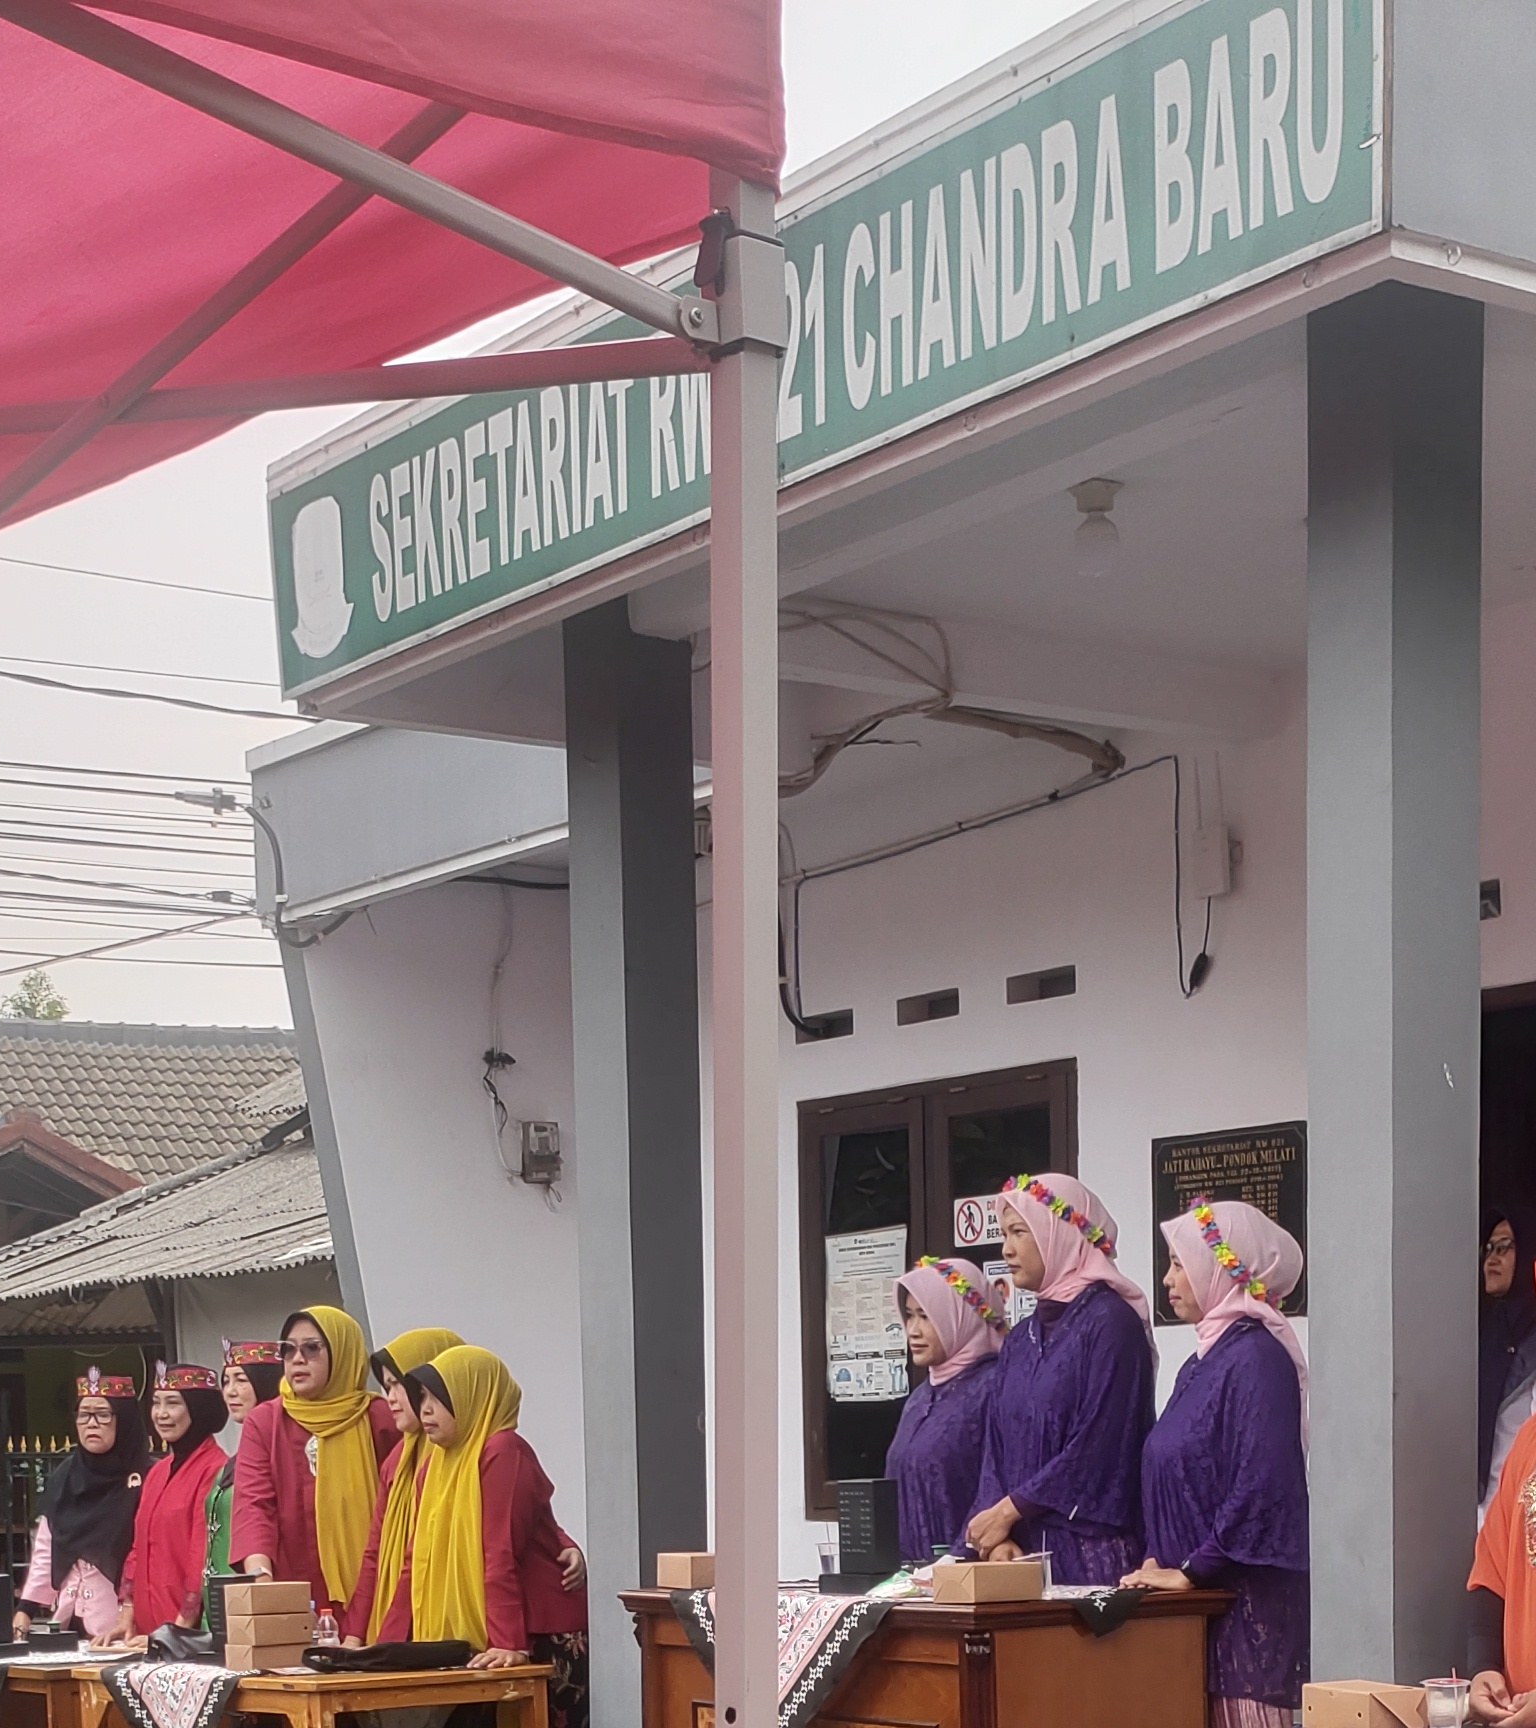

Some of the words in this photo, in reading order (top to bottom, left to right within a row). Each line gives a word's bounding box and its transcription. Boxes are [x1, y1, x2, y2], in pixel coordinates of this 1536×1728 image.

[369, 382, 631, 622] SEKRETARIAT
[843, 94, 1130, 411] CHANDRA
[1153, 0, 1344, 275] BARU
[1260, 1147, 1296, 1162] MELATI
